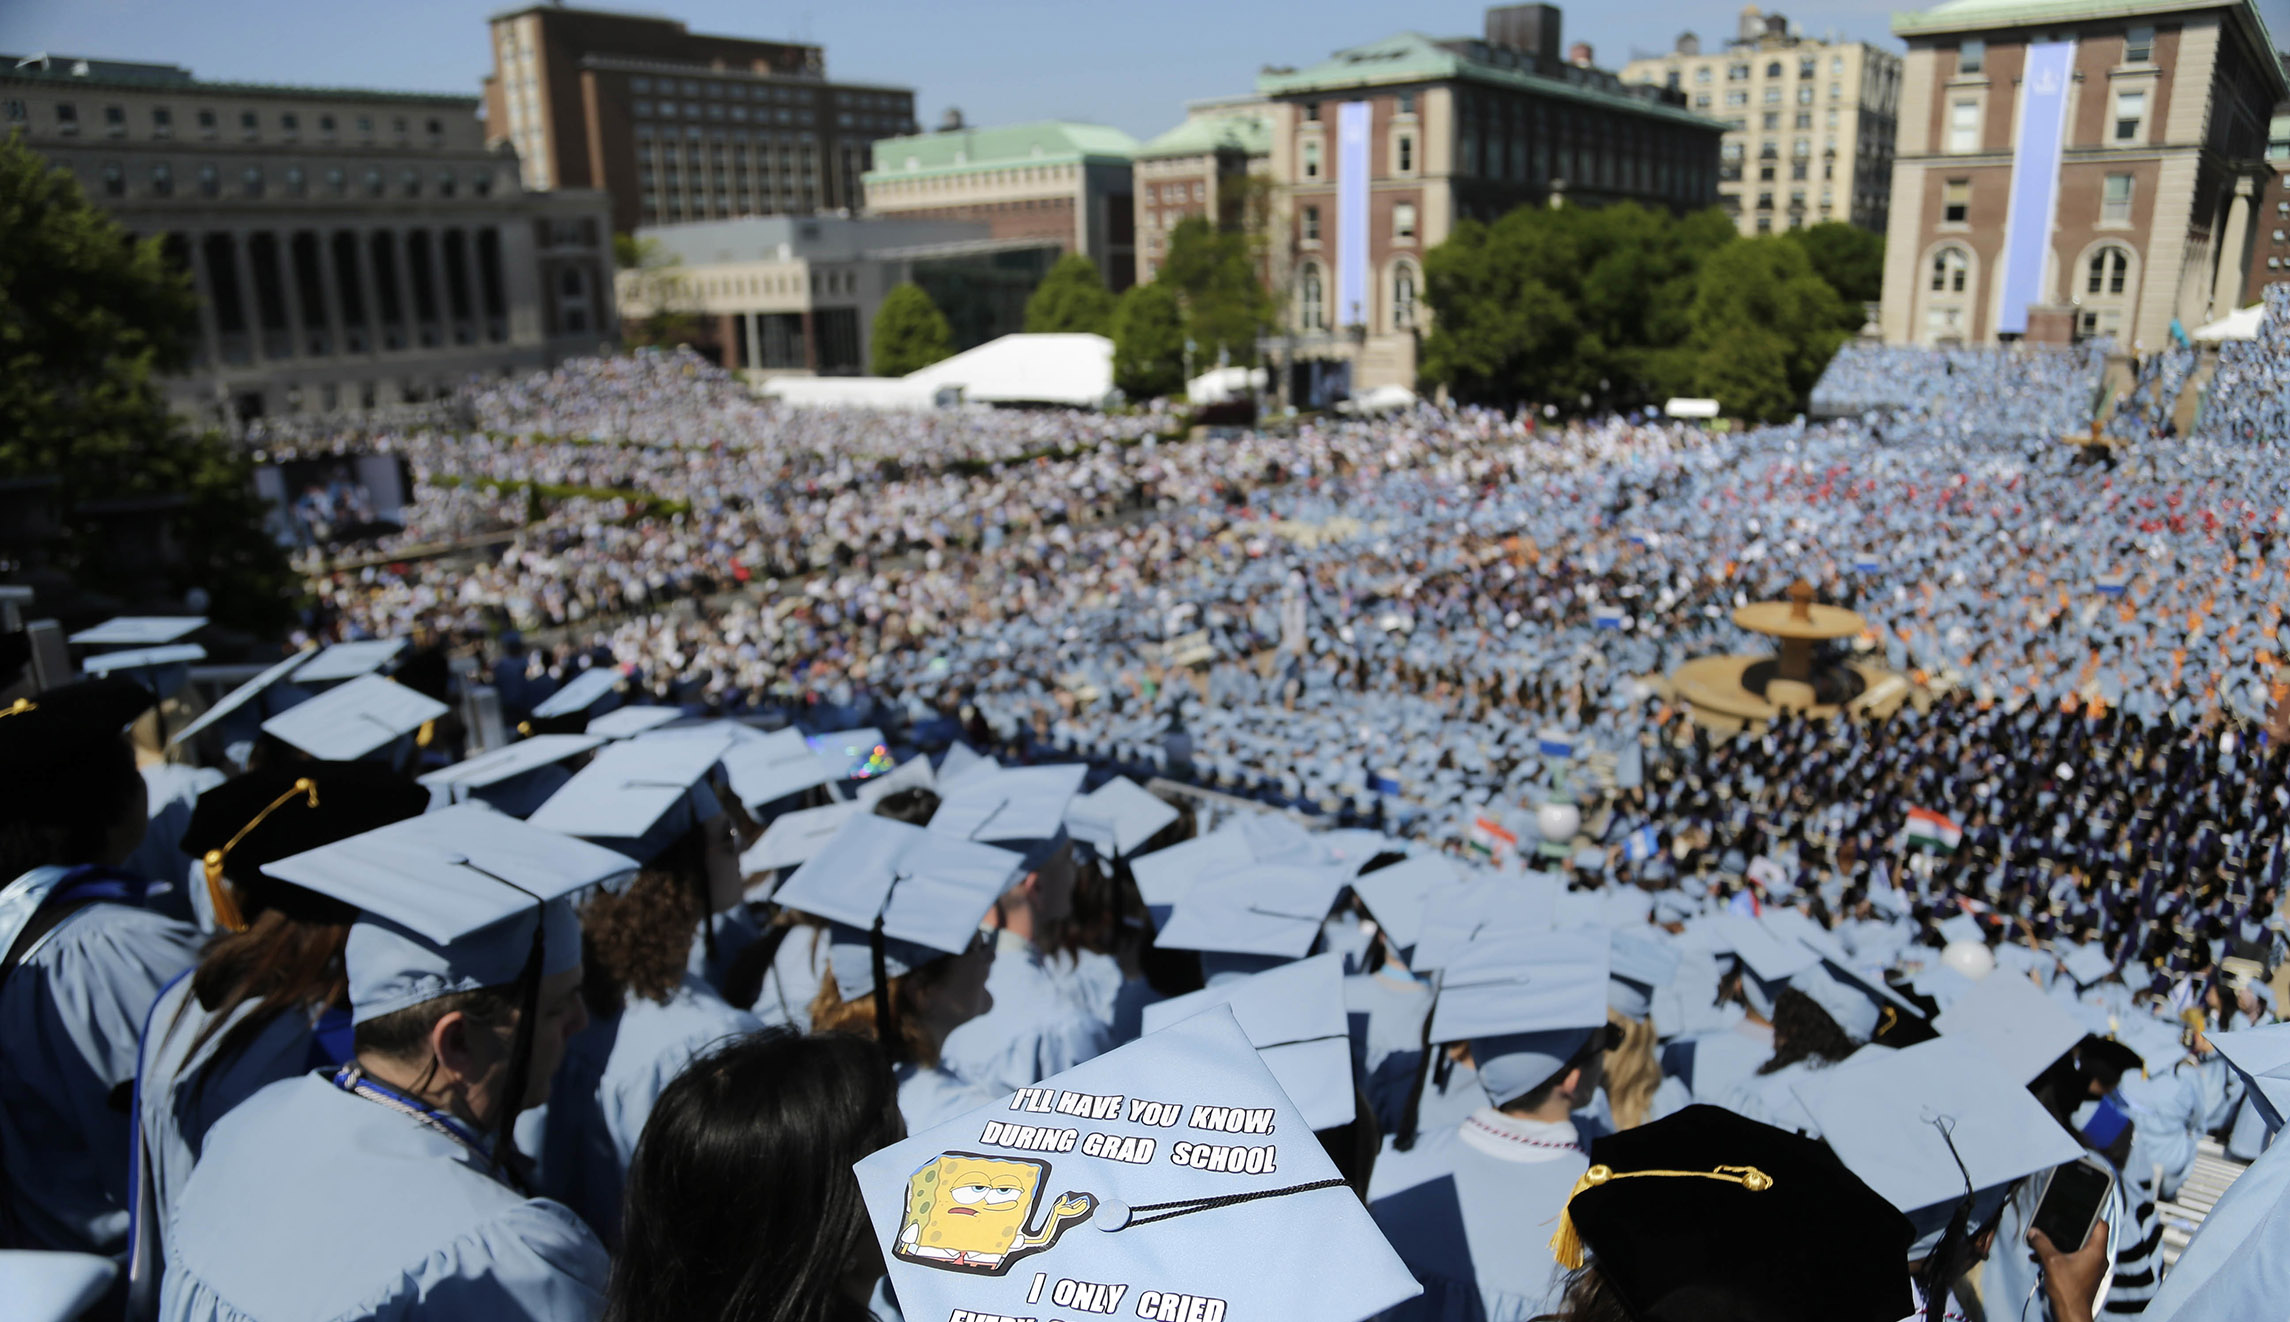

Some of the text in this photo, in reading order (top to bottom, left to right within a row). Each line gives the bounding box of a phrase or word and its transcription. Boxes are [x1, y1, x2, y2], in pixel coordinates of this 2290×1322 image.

[1009, 1087, 1276, 1136] I'LL HAVE YOU KNOW,
[979, 1120, 1276, 1175] DURING GRAD SCHOOL
[1026, 1272, 1047, 1304] I
[1052, 1278, 1129, 1315] ONLY
[1135, 1290, 1229, 1322] CRIED
